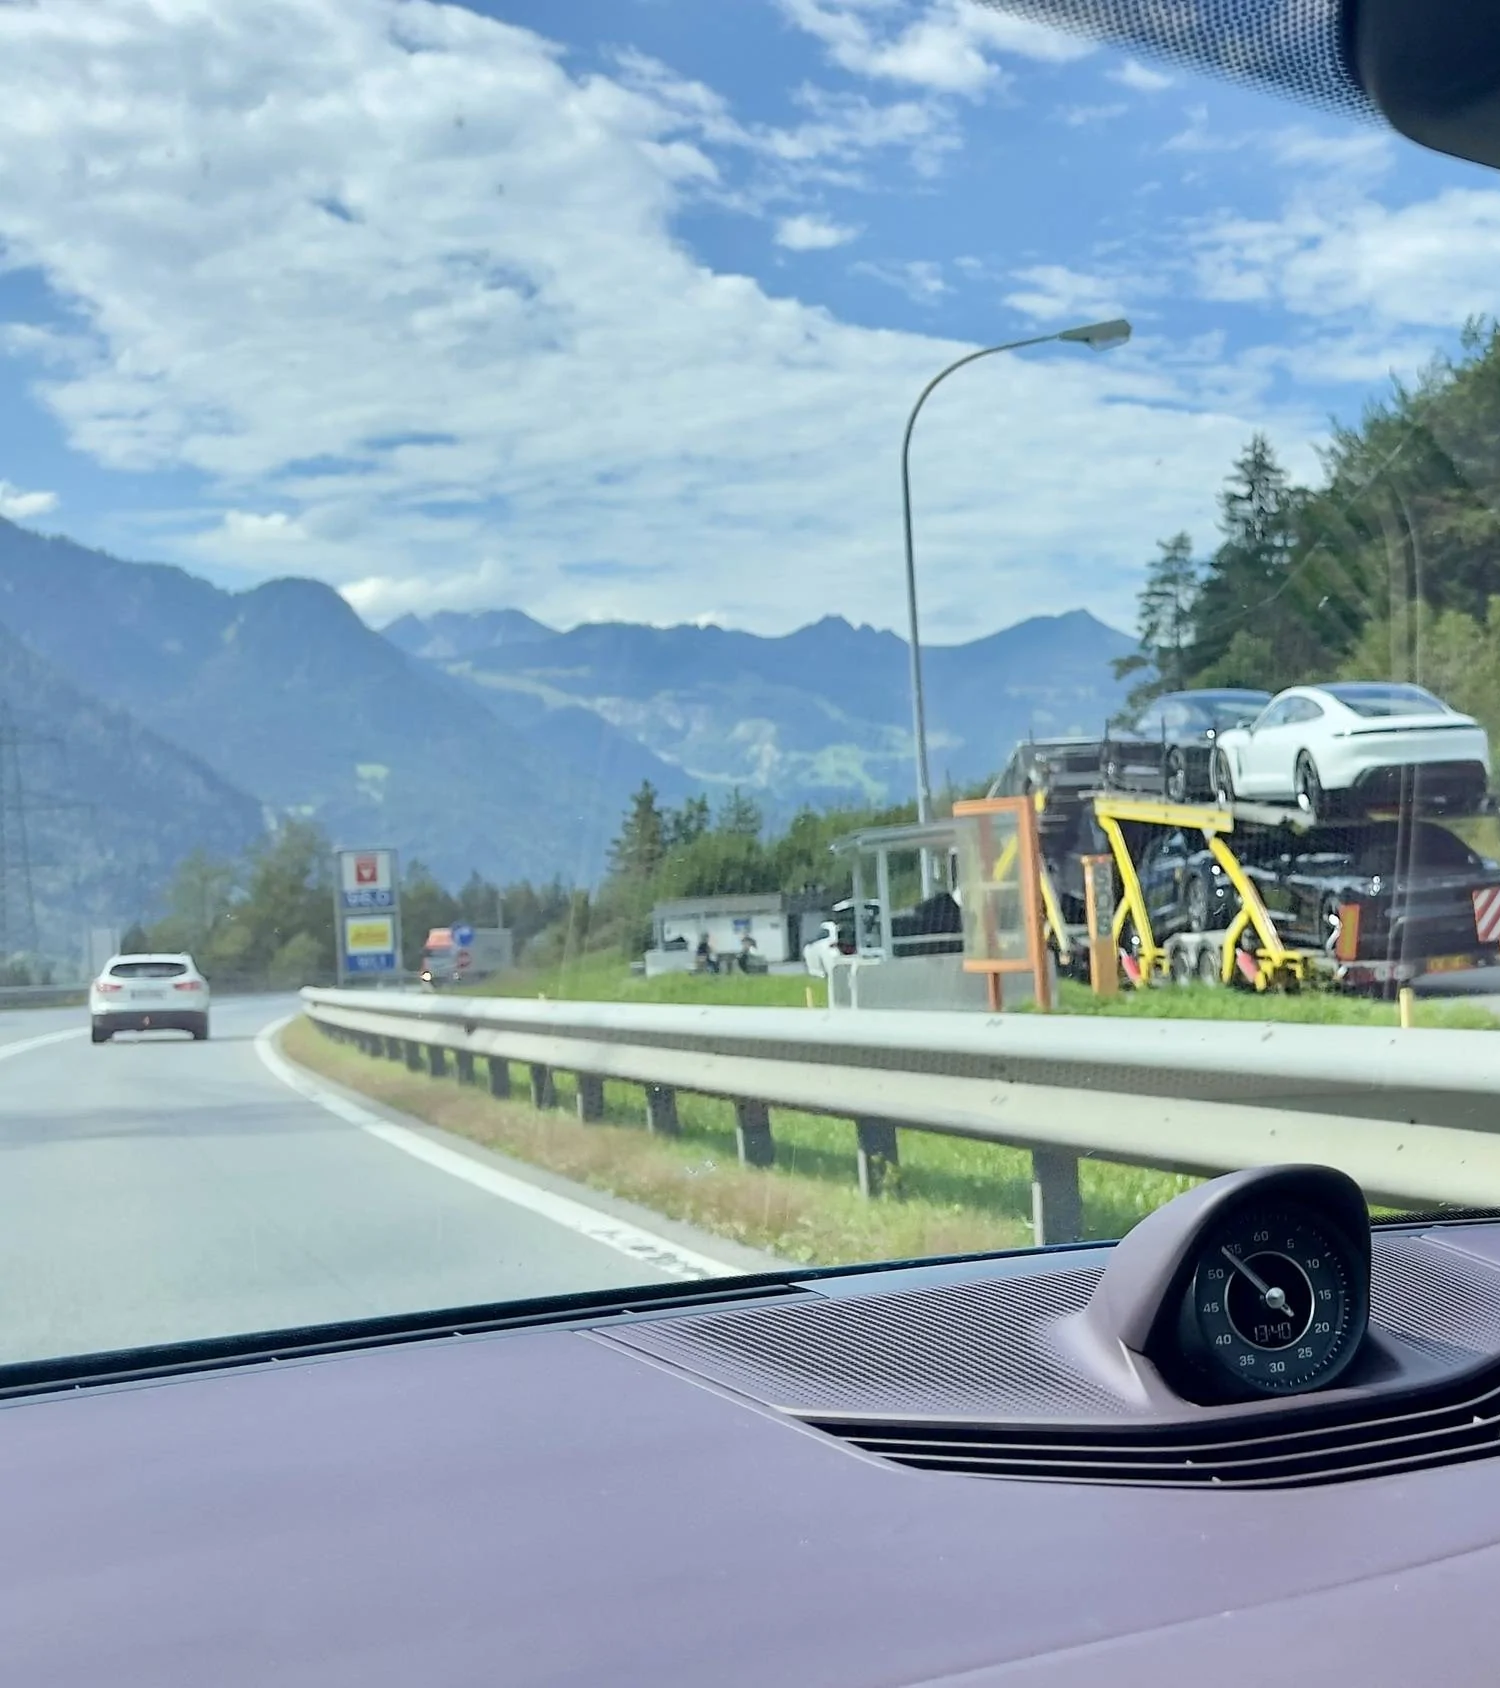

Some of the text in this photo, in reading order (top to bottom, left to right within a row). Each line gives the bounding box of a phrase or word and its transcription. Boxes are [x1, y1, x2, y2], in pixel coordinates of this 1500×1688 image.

[1253, 1230, 1269, 1242] 60
[1286, 1238, 1295, 1249] 5
[1306, 1258, 1320, 1269] 10
[1207, 1269, 1224, 1280] 50
[1318, 1289, 1332, 1300] 15
[1203, 1302, 1219, 1313] 45
[1314, 1322, 1330, 1334] 20
[1215, 1334, 1232, 1345] 40
[1297, 1347, 1313, 1359] 25
[1239, 1354, 1255, 1367] 35
[1269, 1361, 1286, 1373] 30
